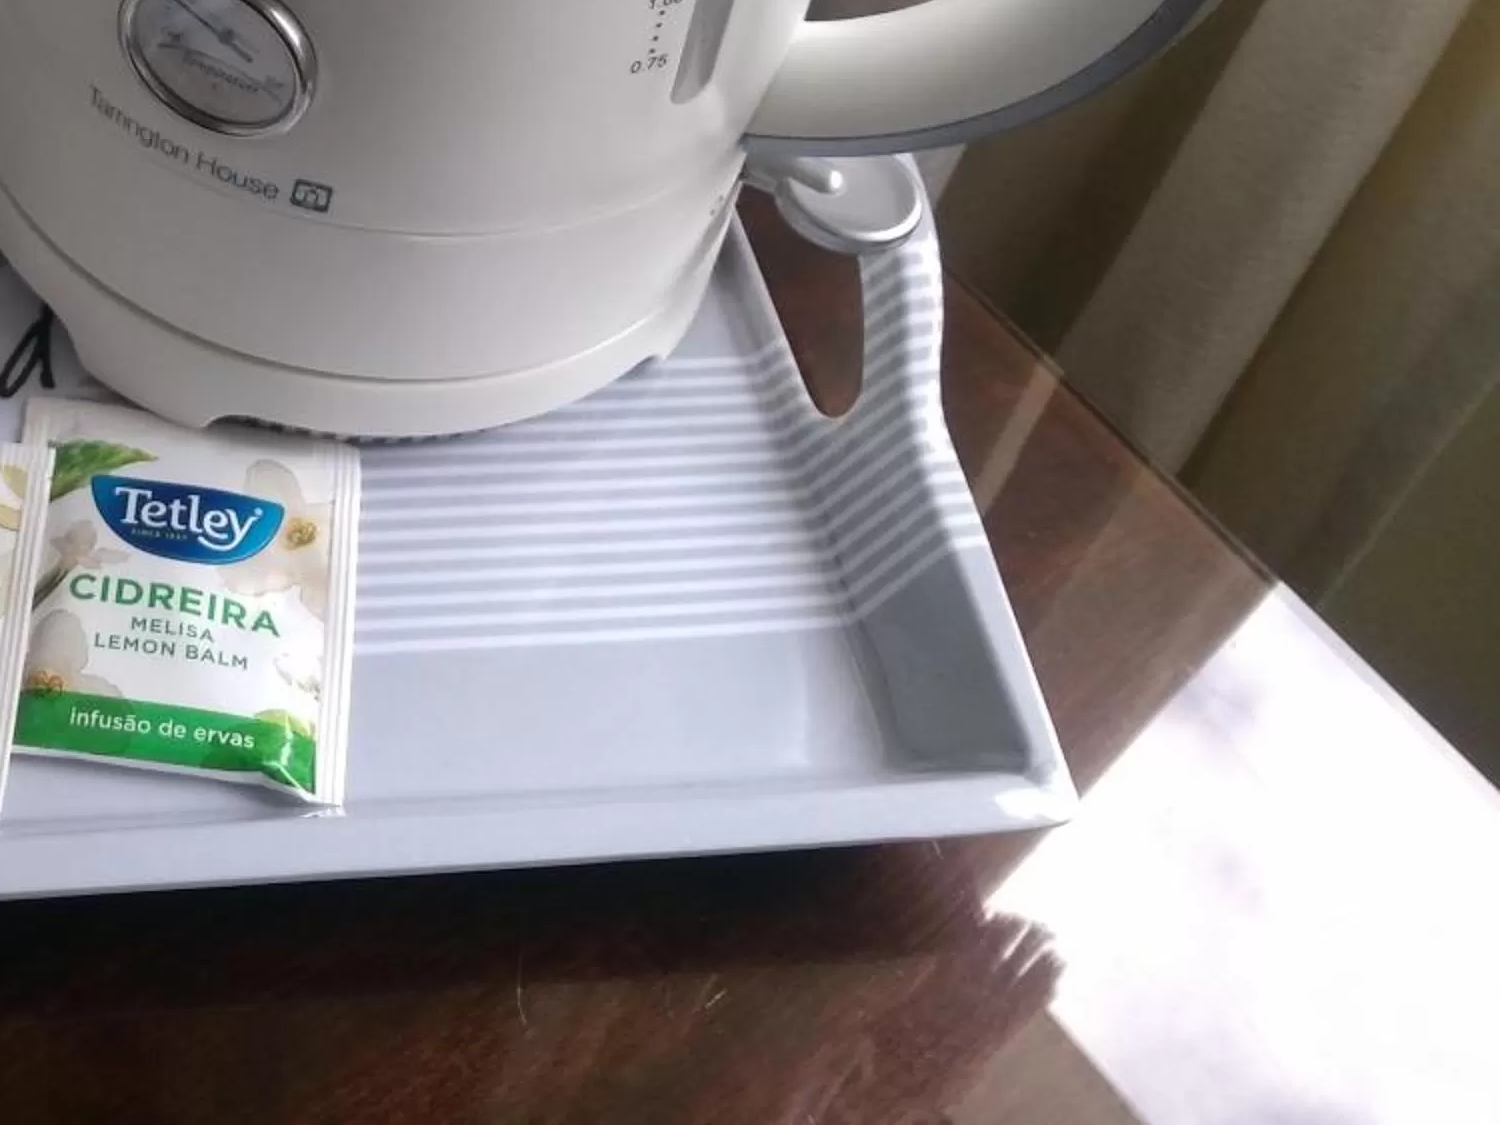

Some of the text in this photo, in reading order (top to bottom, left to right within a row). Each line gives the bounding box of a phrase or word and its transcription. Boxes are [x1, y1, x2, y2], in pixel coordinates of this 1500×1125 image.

[629, 53, 669, 75] 0.75
[89, 82, 280, 201] Tarrington House
[115, 486, 263, 551] Tetley
[69, 573, 281, 638] CIDREIRA
[130, 615, 215, 643] MELISA
[94, 632, 249, 671] LEMON BALM
[69, 706, 255, 749] infusão de ervas
